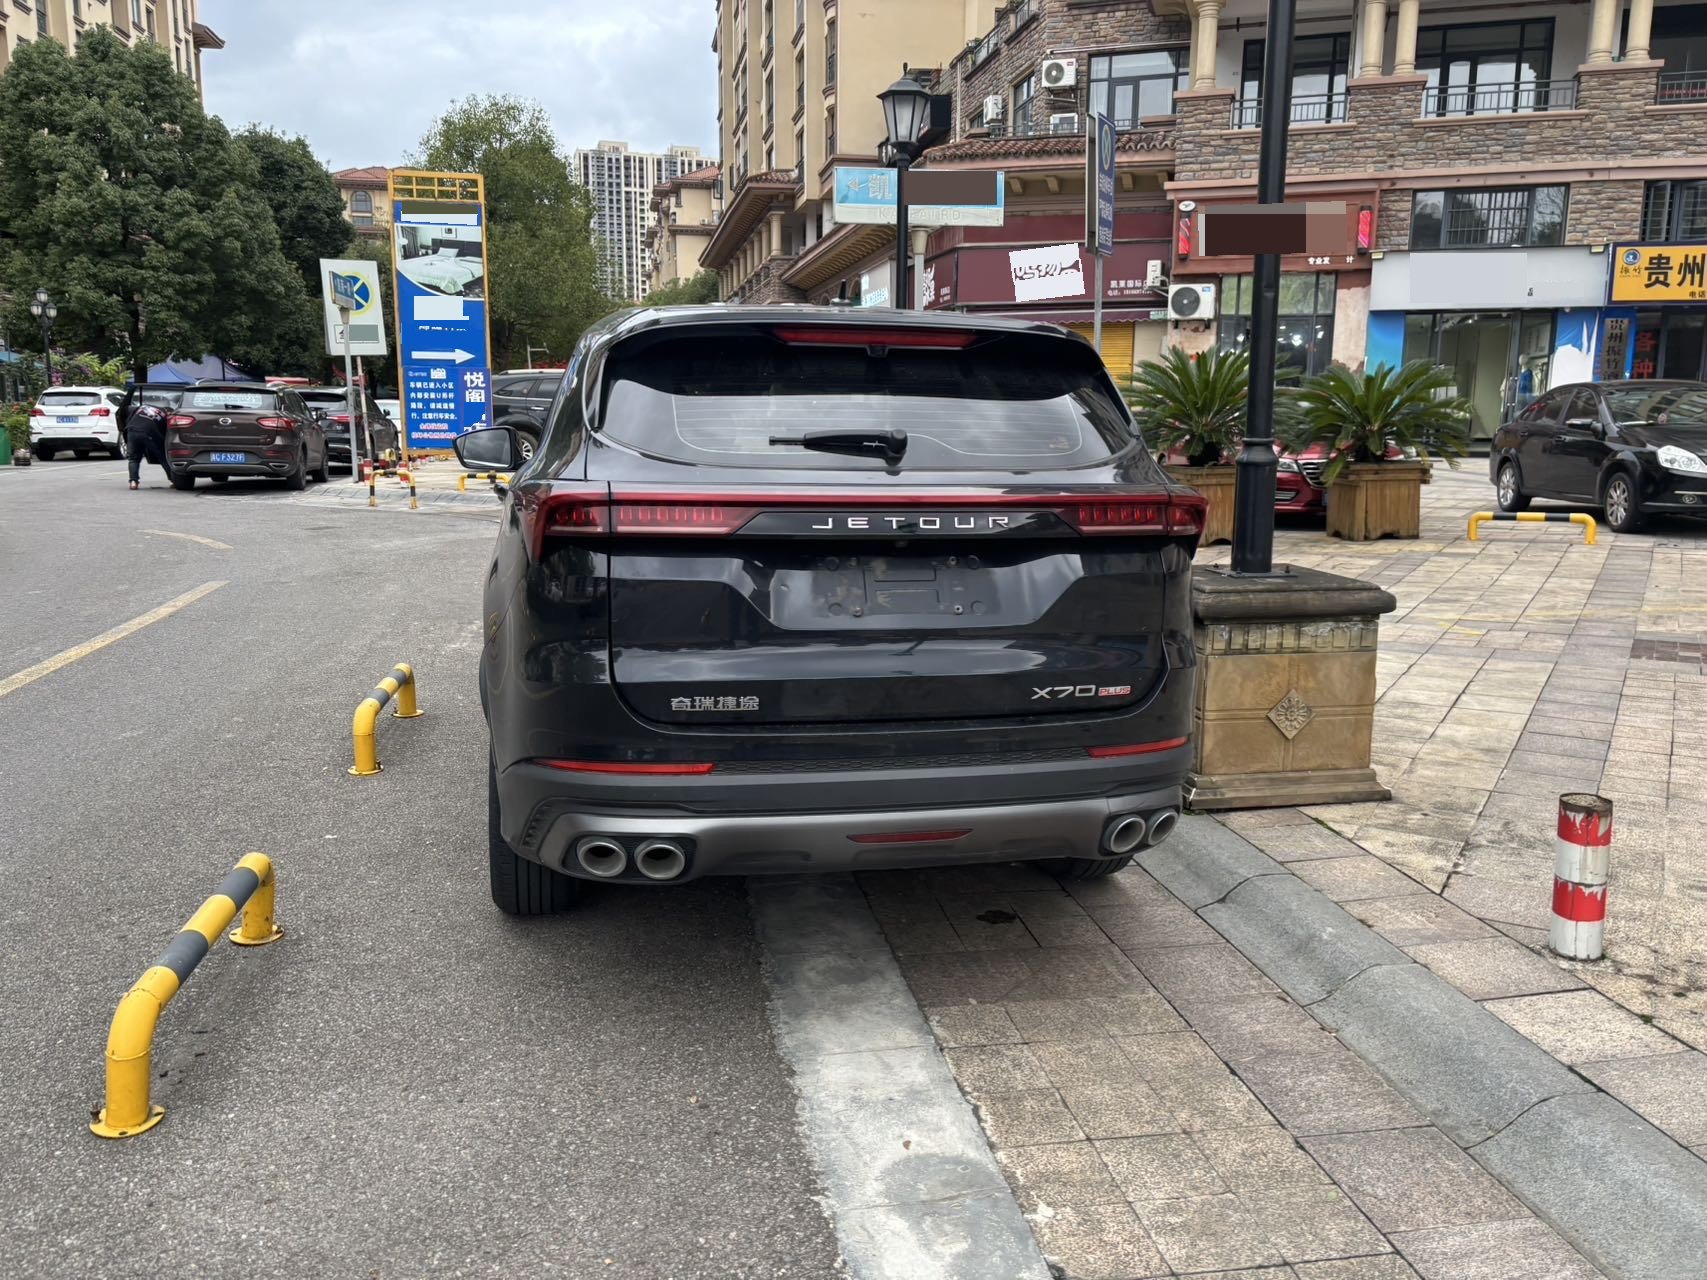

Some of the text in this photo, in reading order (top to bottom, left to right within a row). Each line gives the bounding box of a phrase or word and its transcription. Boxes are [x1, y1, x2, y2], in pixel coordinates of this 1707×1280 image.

[1644, 253, 1706, 289] 贵州
[812, 516, 1009, 530] JETOUR
[1031, 684, 1097, 700] X70
[670, 695, 760, 712] 奇瑞捷途
